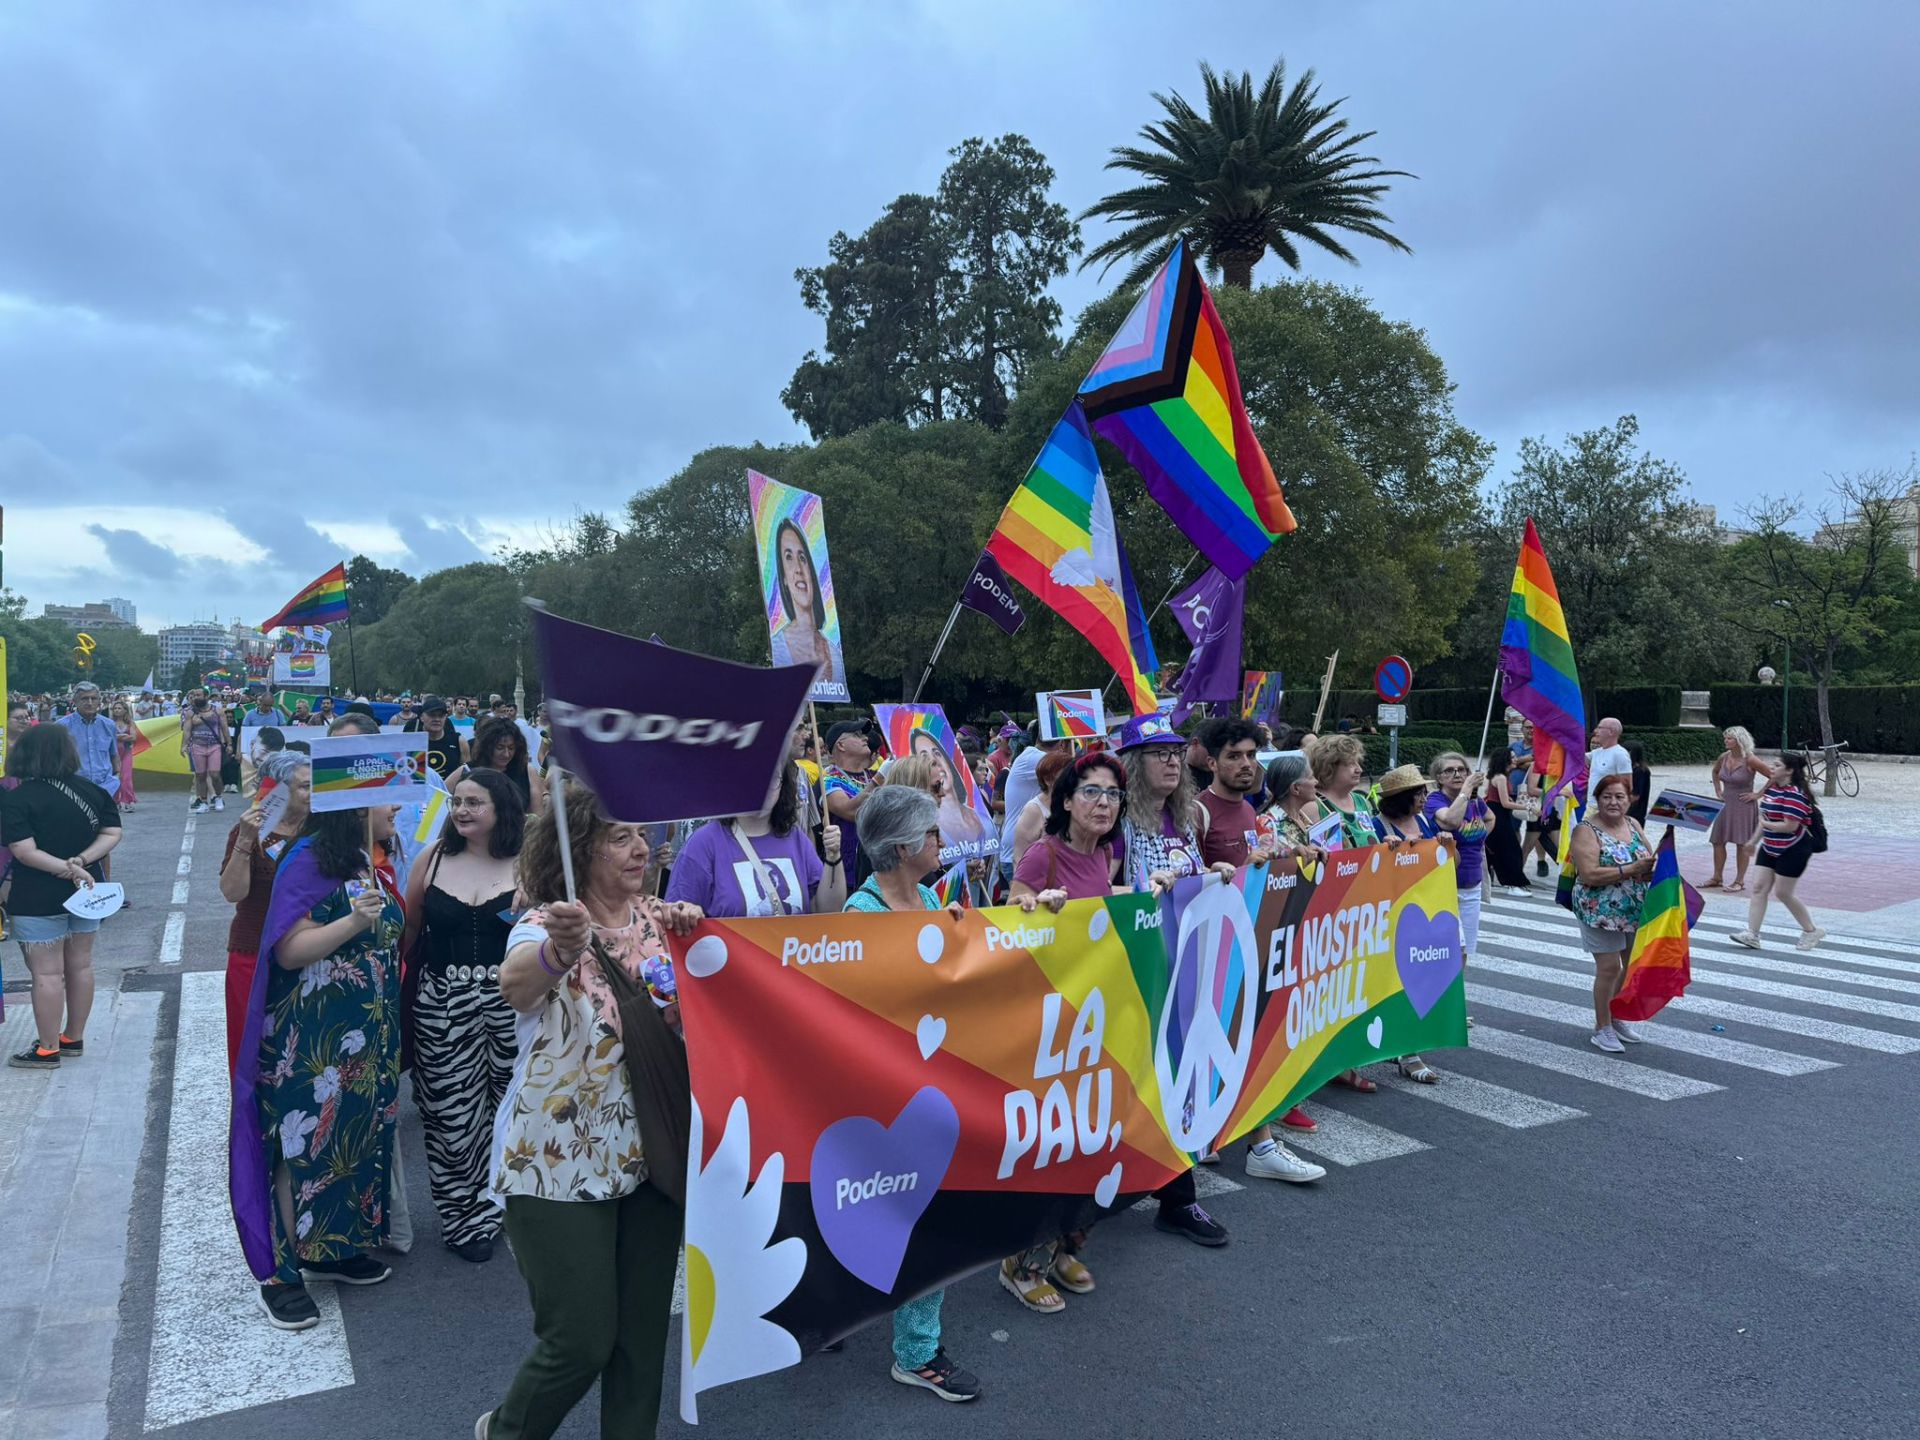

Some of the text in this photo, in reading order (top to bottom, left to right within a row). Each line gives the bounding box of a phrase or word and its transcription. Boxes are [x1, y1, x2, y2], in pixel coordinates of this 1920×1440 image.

[973, 572, 1020, 615] PODEM
[810, 679, 845, 696] ontero
[549, 698, 764, 750] PODEM
[1057, 709, 1088, 719] Podem
[359, 764, 392, 773] NOSTRE
[939, 846, 961, 860] rene
[1395, 851, 1419, 866] Podem
[1267, 872, 1297, 891] Podem
[1336, 860, 1359, 877] Podem
[782, 934, 863, 967] Podem
[985, 924, 1056, 951] Podem
[1266, 900, 1391, 992] EL NOSTRE
[1409, 945, 1450, 963] Podem
[1286, 960, 1368, 1050] ORGULL
[1034, 987, 1105, 1080] LA
[997, 1068, 1122, 1180] PAU,
[836, 1171, 918, 1211] Podem
